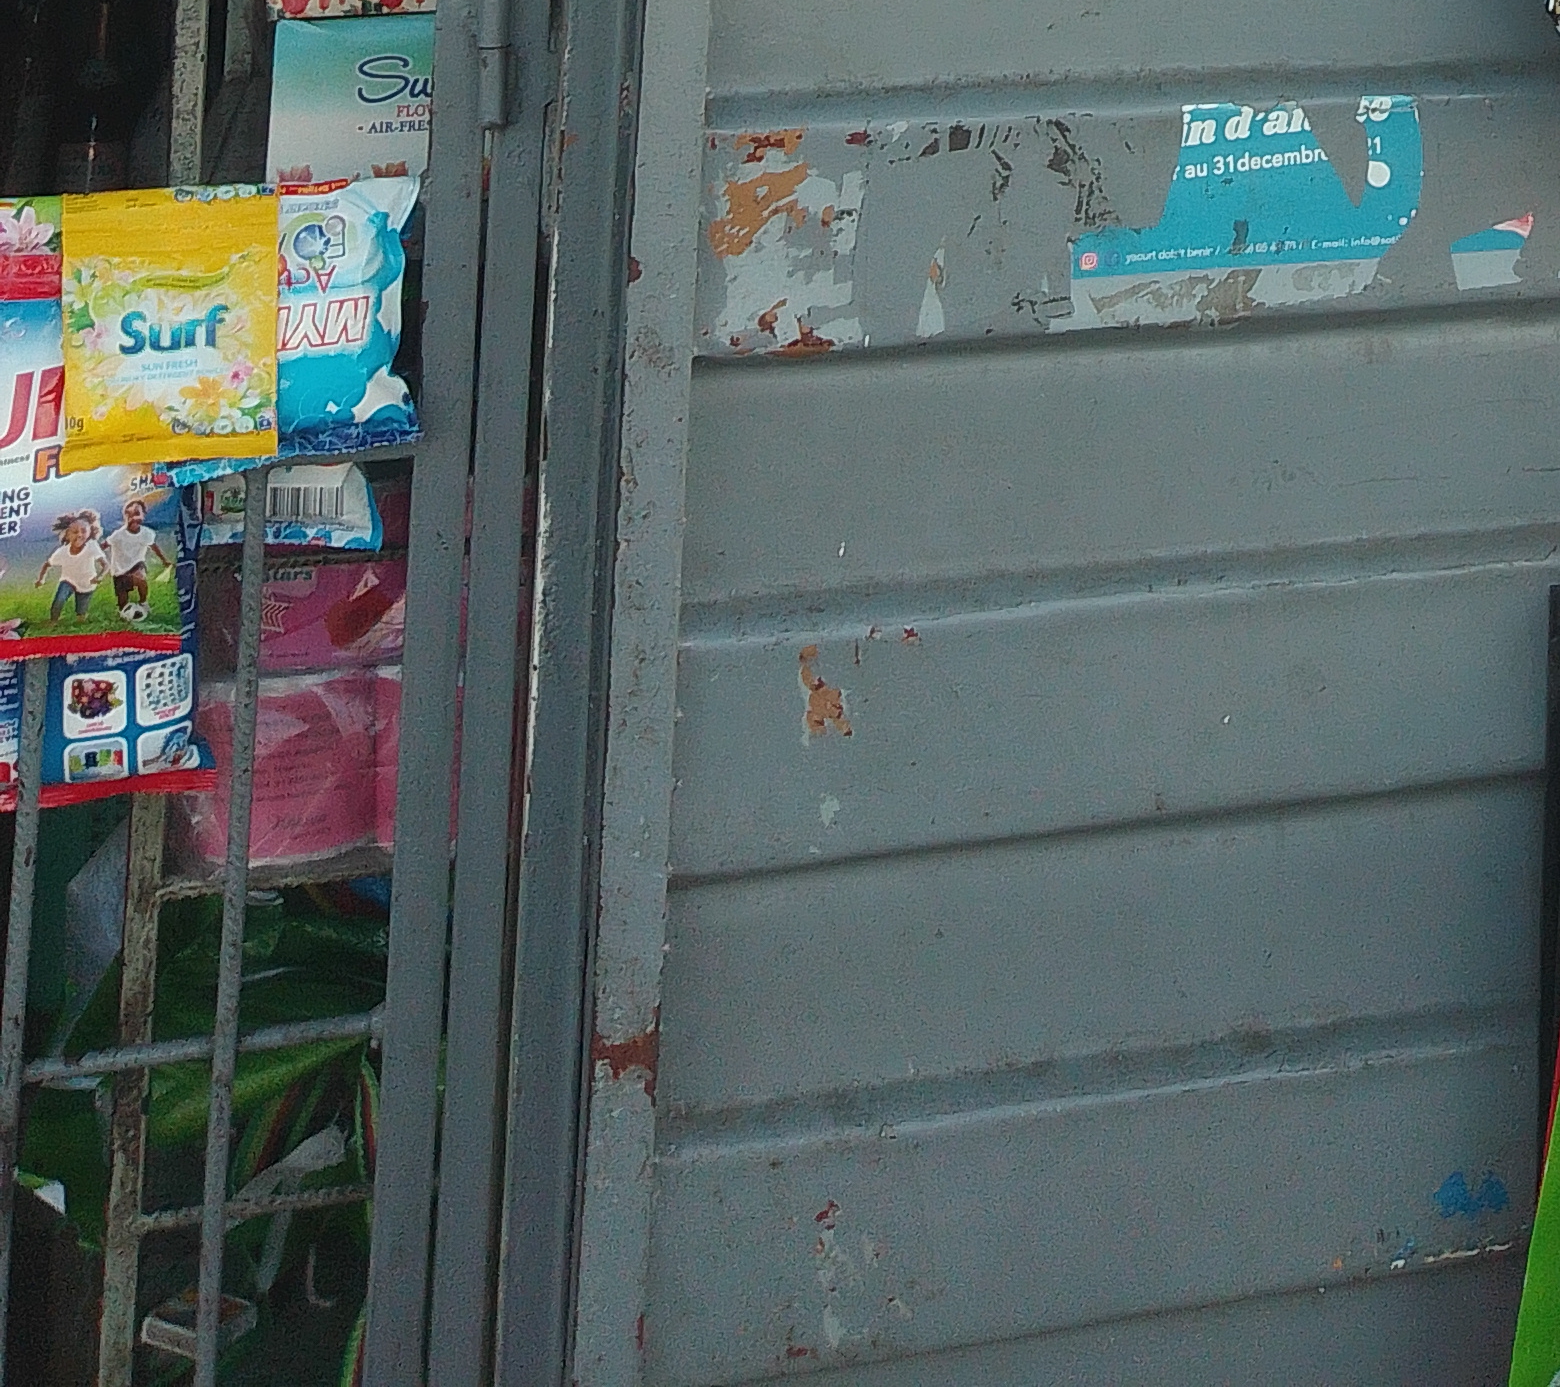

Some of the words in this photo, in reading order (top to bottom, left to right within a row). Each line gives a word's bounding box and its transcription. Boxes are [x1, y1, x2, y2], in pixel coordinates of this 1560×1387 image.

[1184, 162, 1208, 179] au
[119, 303, 230, 355] Surf
[141, 362, 164, 372] SUN
[165, 358, 198, 371] FRESH
